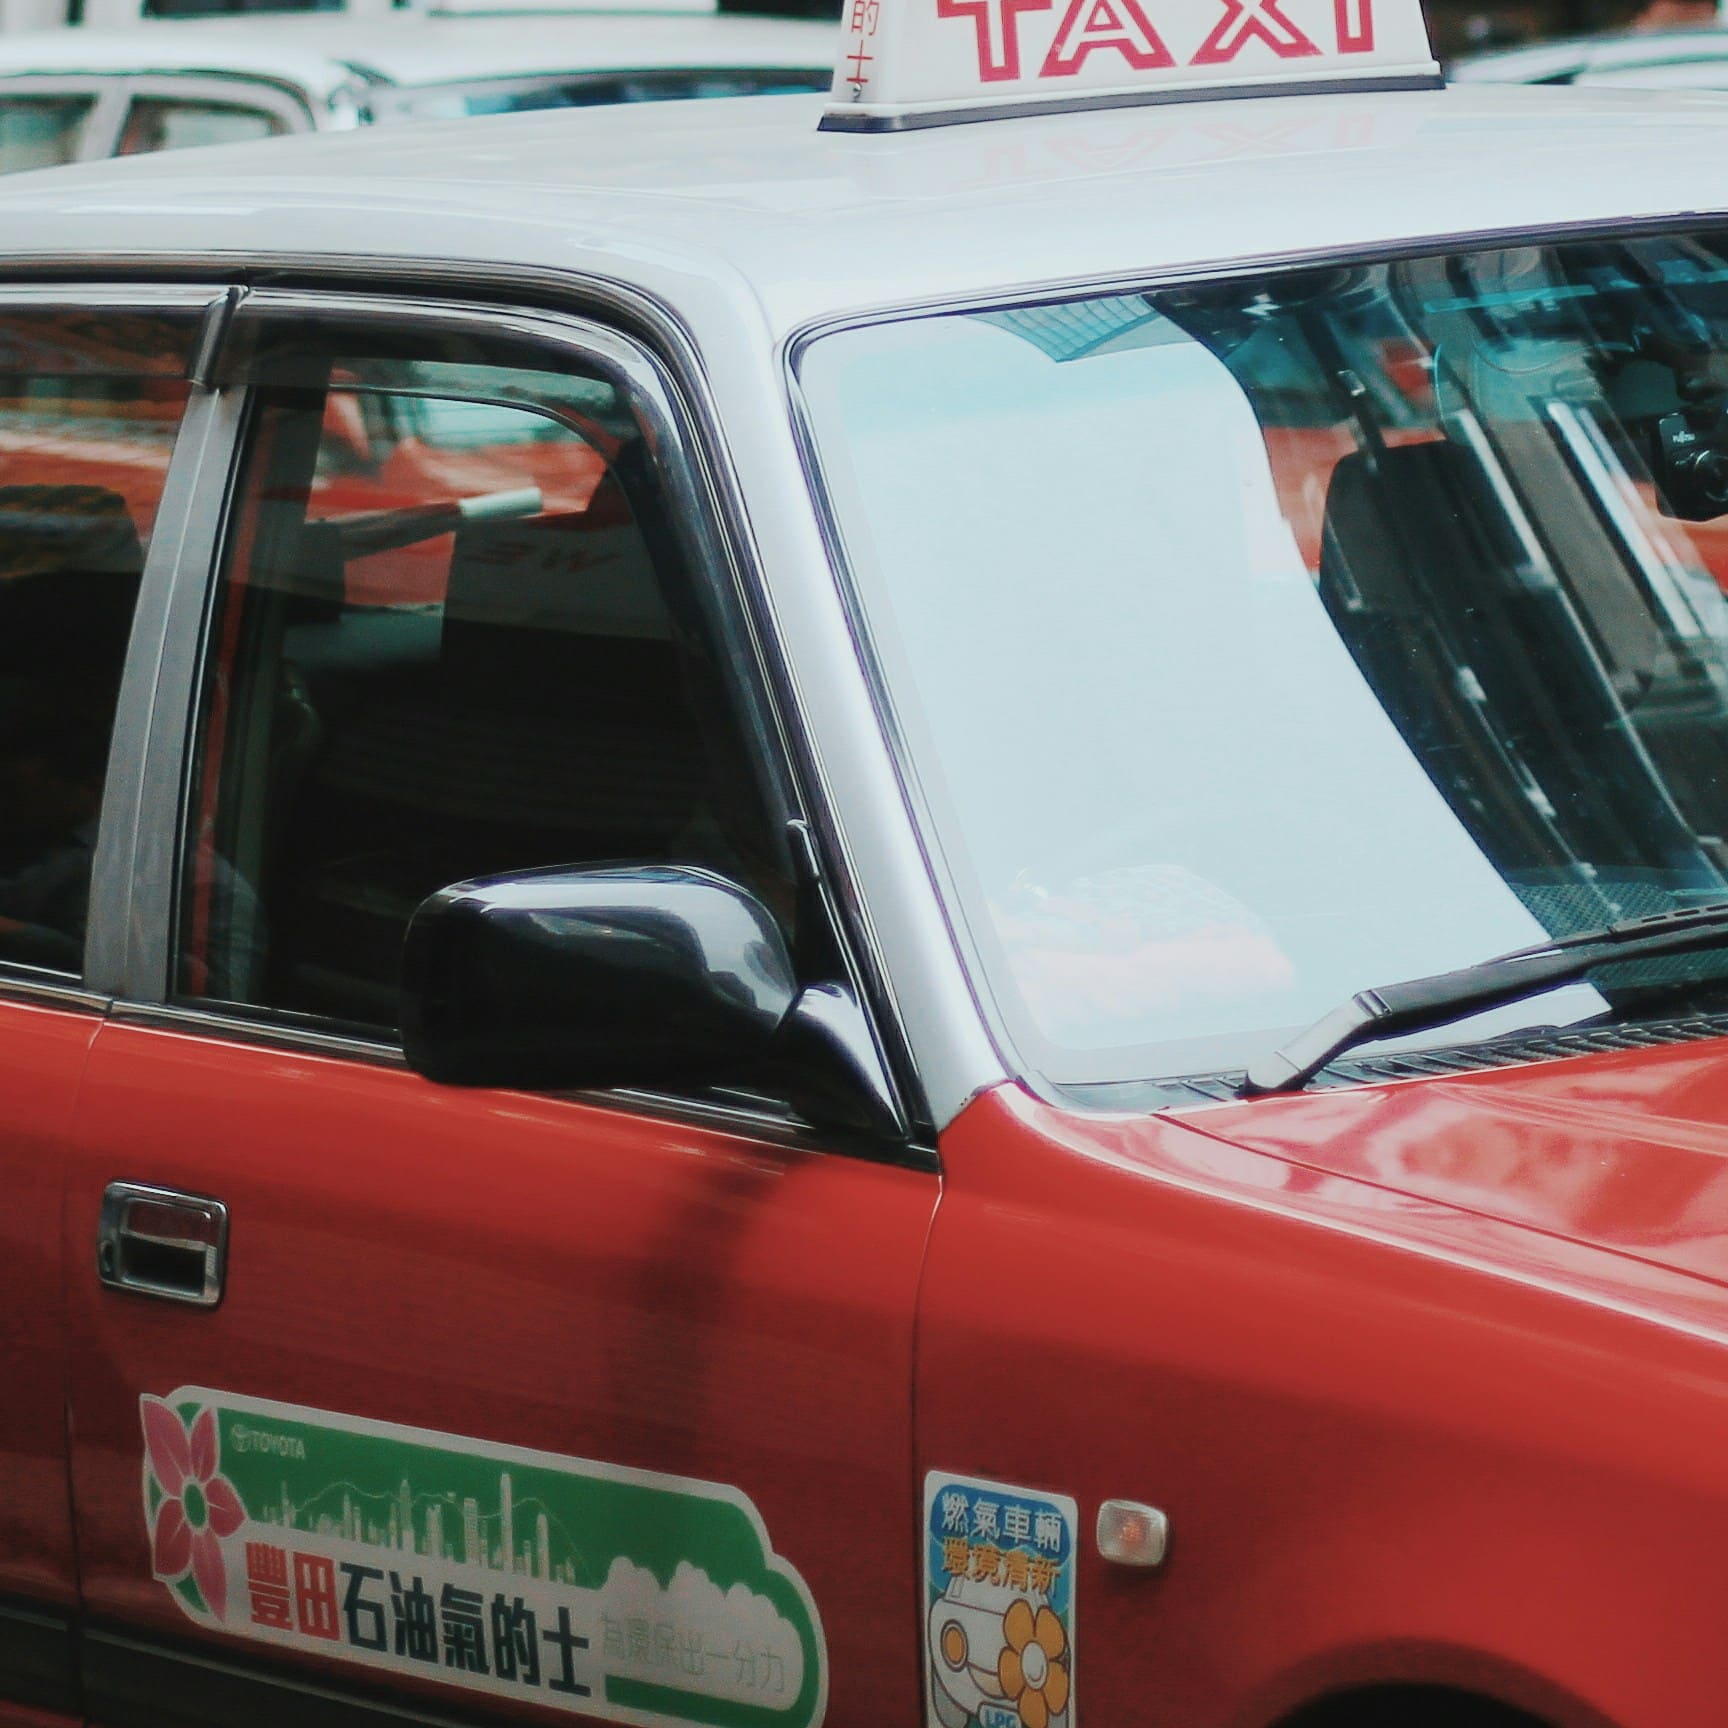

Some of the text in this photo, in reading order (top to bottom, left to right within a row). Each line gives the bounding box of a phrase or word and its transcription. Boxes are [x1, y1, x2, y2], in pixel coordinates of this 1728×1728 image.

[248, 1430, 306, 1460] TOYOTA
[941, 1489, 1064, 1556] 燃氣車輛
[246, 1540, 593, 1698] 豐田石油氣的士
